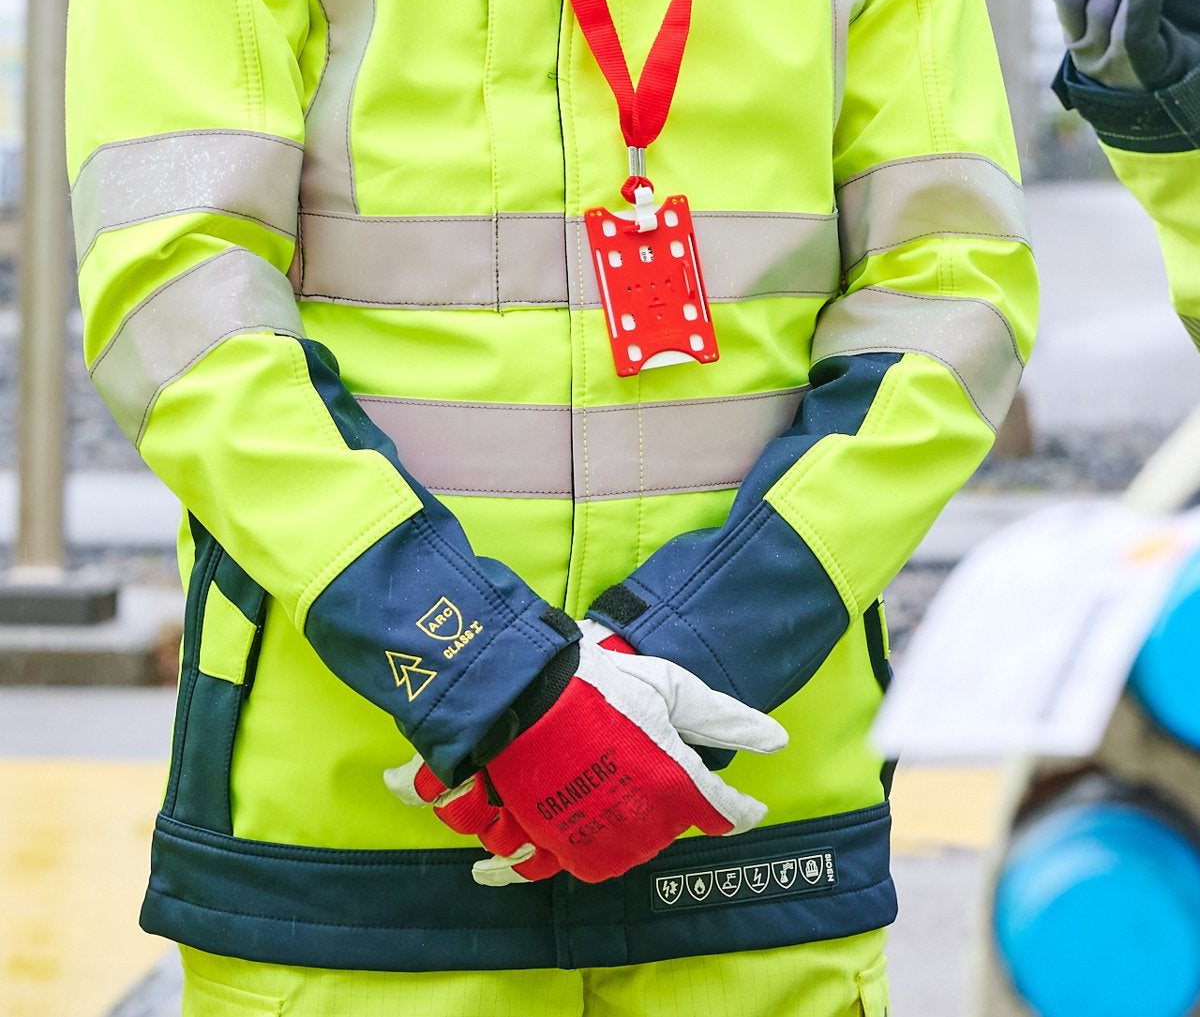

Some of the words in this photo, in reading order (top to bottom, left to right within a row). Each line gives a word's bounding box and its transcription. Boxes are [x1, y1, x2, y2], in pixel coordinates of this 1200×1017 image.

[428, 607, 453, 632] ARC
[443, 630, 475, 659] CLASS
[535, 754, 618, 821] GRANBERG
